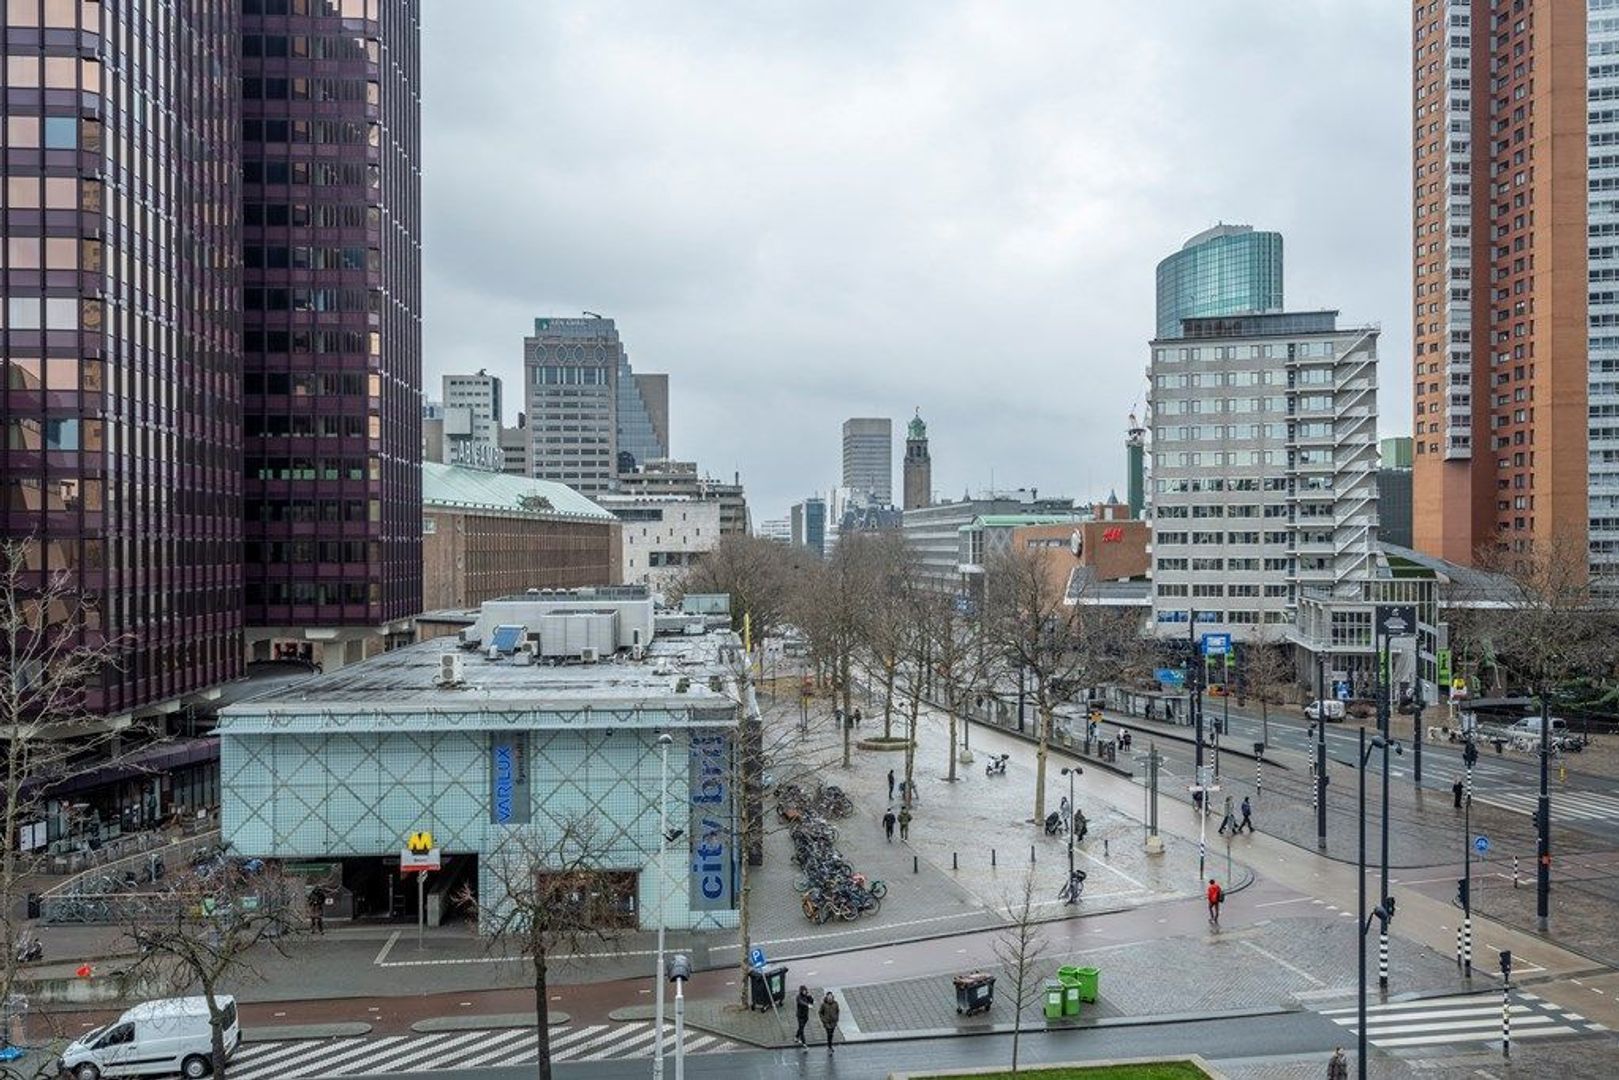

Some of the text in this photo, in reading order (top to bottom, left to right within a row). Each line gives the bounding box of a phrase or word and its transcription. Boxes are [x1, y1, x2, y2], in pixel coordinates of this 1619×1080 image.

[497, 747, 512, 823] VARILUX
[693, 818, 726, 899] city
[752, 950, 760, 961] P
